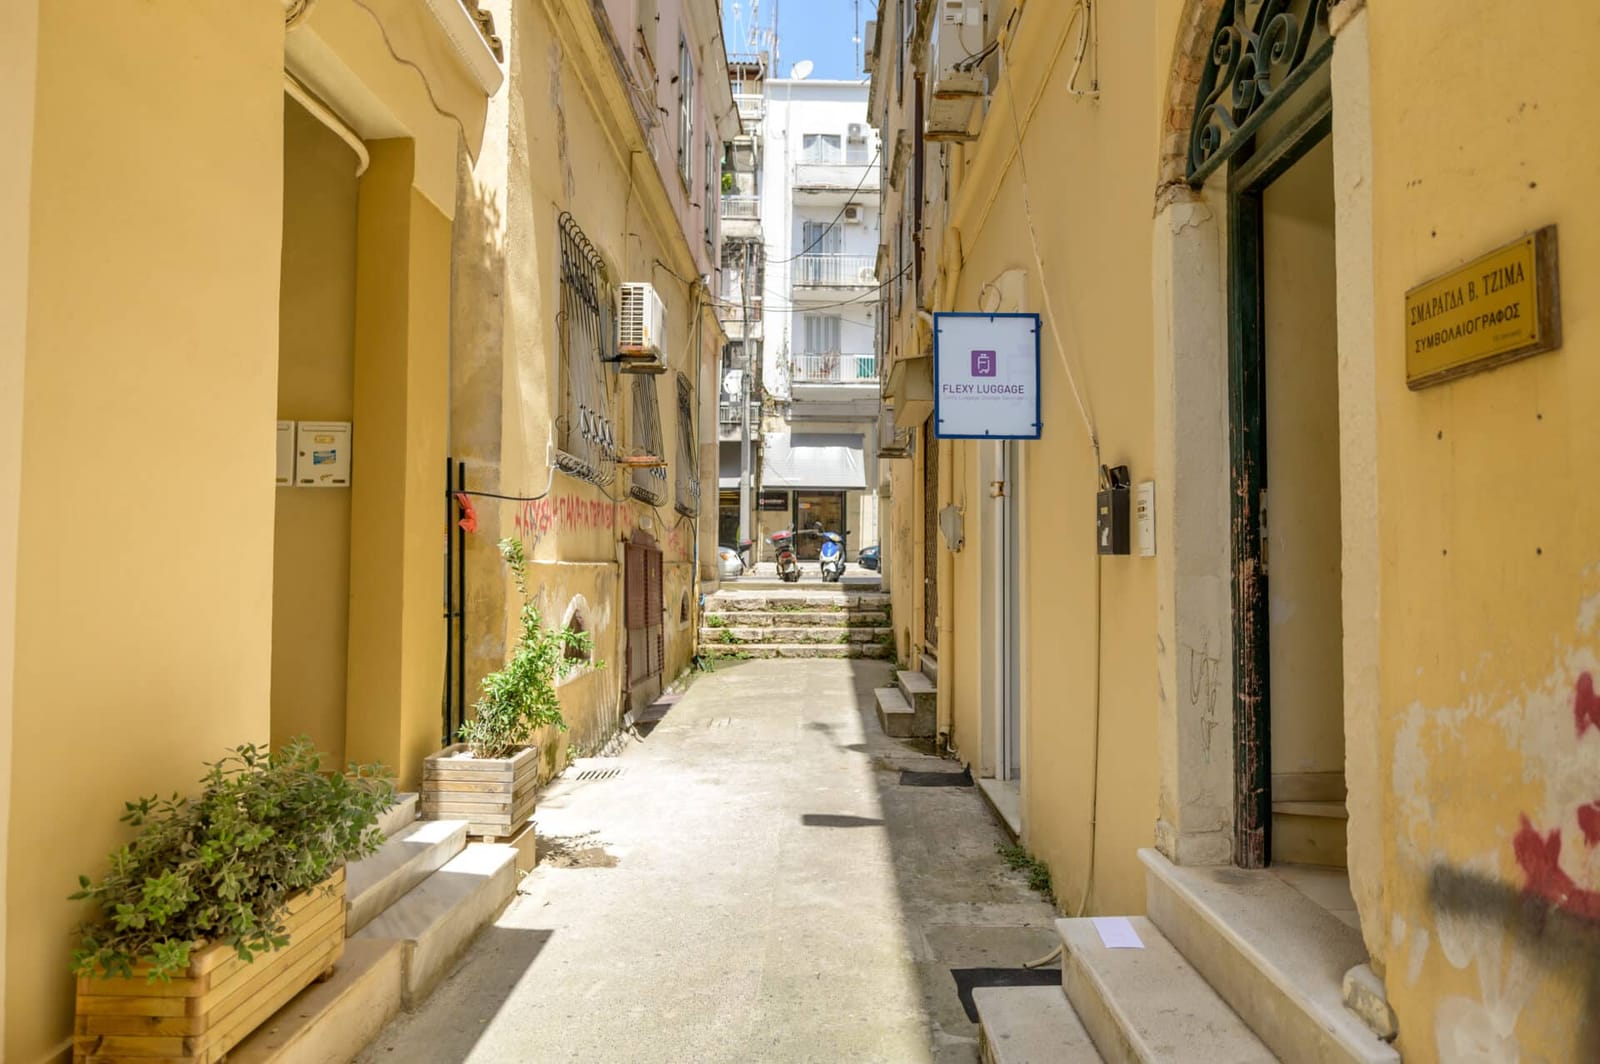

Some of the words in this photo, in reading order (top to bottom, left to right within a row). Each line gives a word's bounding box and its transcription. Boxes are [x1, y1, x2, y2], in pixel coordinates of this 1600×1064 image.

[1410, 286, 1464, 325] ΣΜΑΡΑΓΔΑ
[1468, 281, 1479, 302] Β.
[1482, 261, 1525, 296] ΤΖΙΜΑ
[1415, 302, 1520, 353] ΣΥΜΒΟΛΑΙΟΓΡΑΦΟΣ
[942, 384, 974, 394] FLEXY
[976, 384, 1024, 394] LUGGAGE
